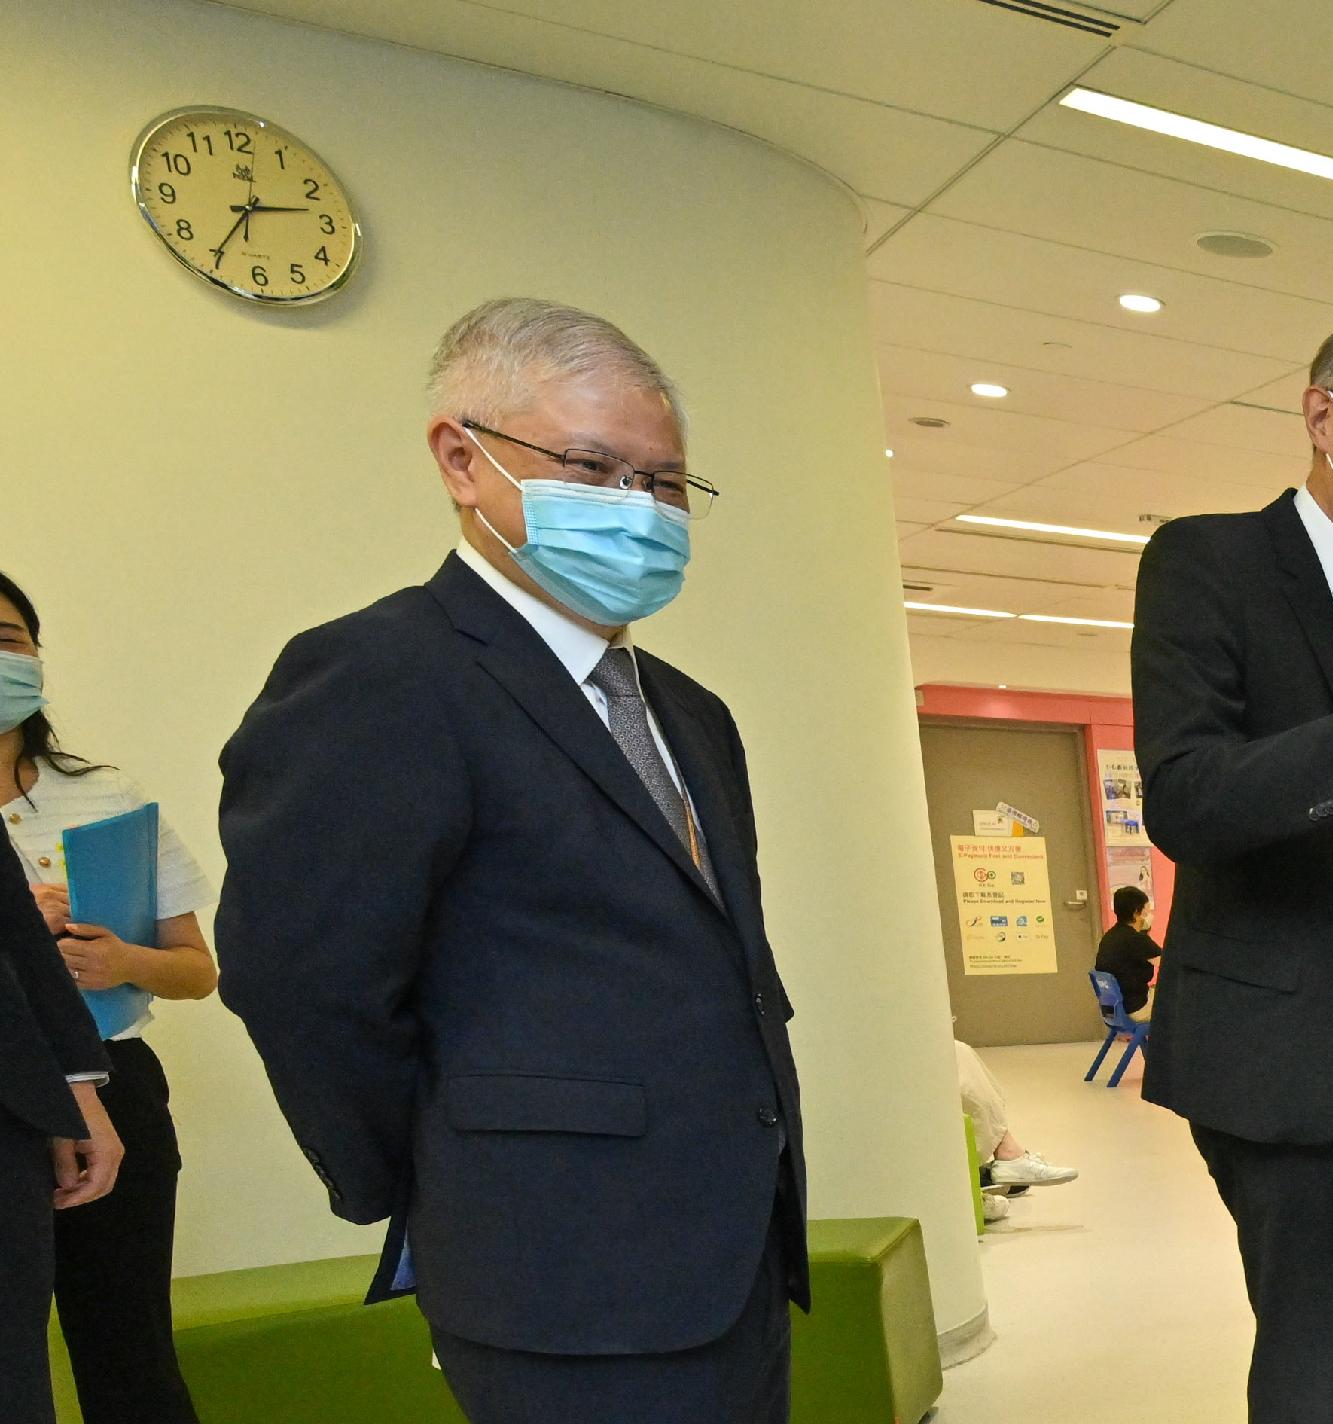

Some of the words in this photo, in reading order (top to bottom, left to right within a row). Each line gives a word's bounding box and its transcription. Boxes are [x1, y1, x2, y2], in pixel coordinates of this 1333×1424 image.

[187, 131, 213, 156] 11
[223, 129, 253, 154] 12
[161, 151, 192, 176] 10
[274, 149, 285, 170] 1
[158, 182, 176, 204] 9
[303, 178, 320, 201] 2
[176, 219, 194, 241] 8
[318, 214, 335, 235] 3
[209, 248, 225, 270] 7
[314, 246, 330, 266] 4
[251, 265, 269, 286] 6
[290, 263, 306, 284] 5
